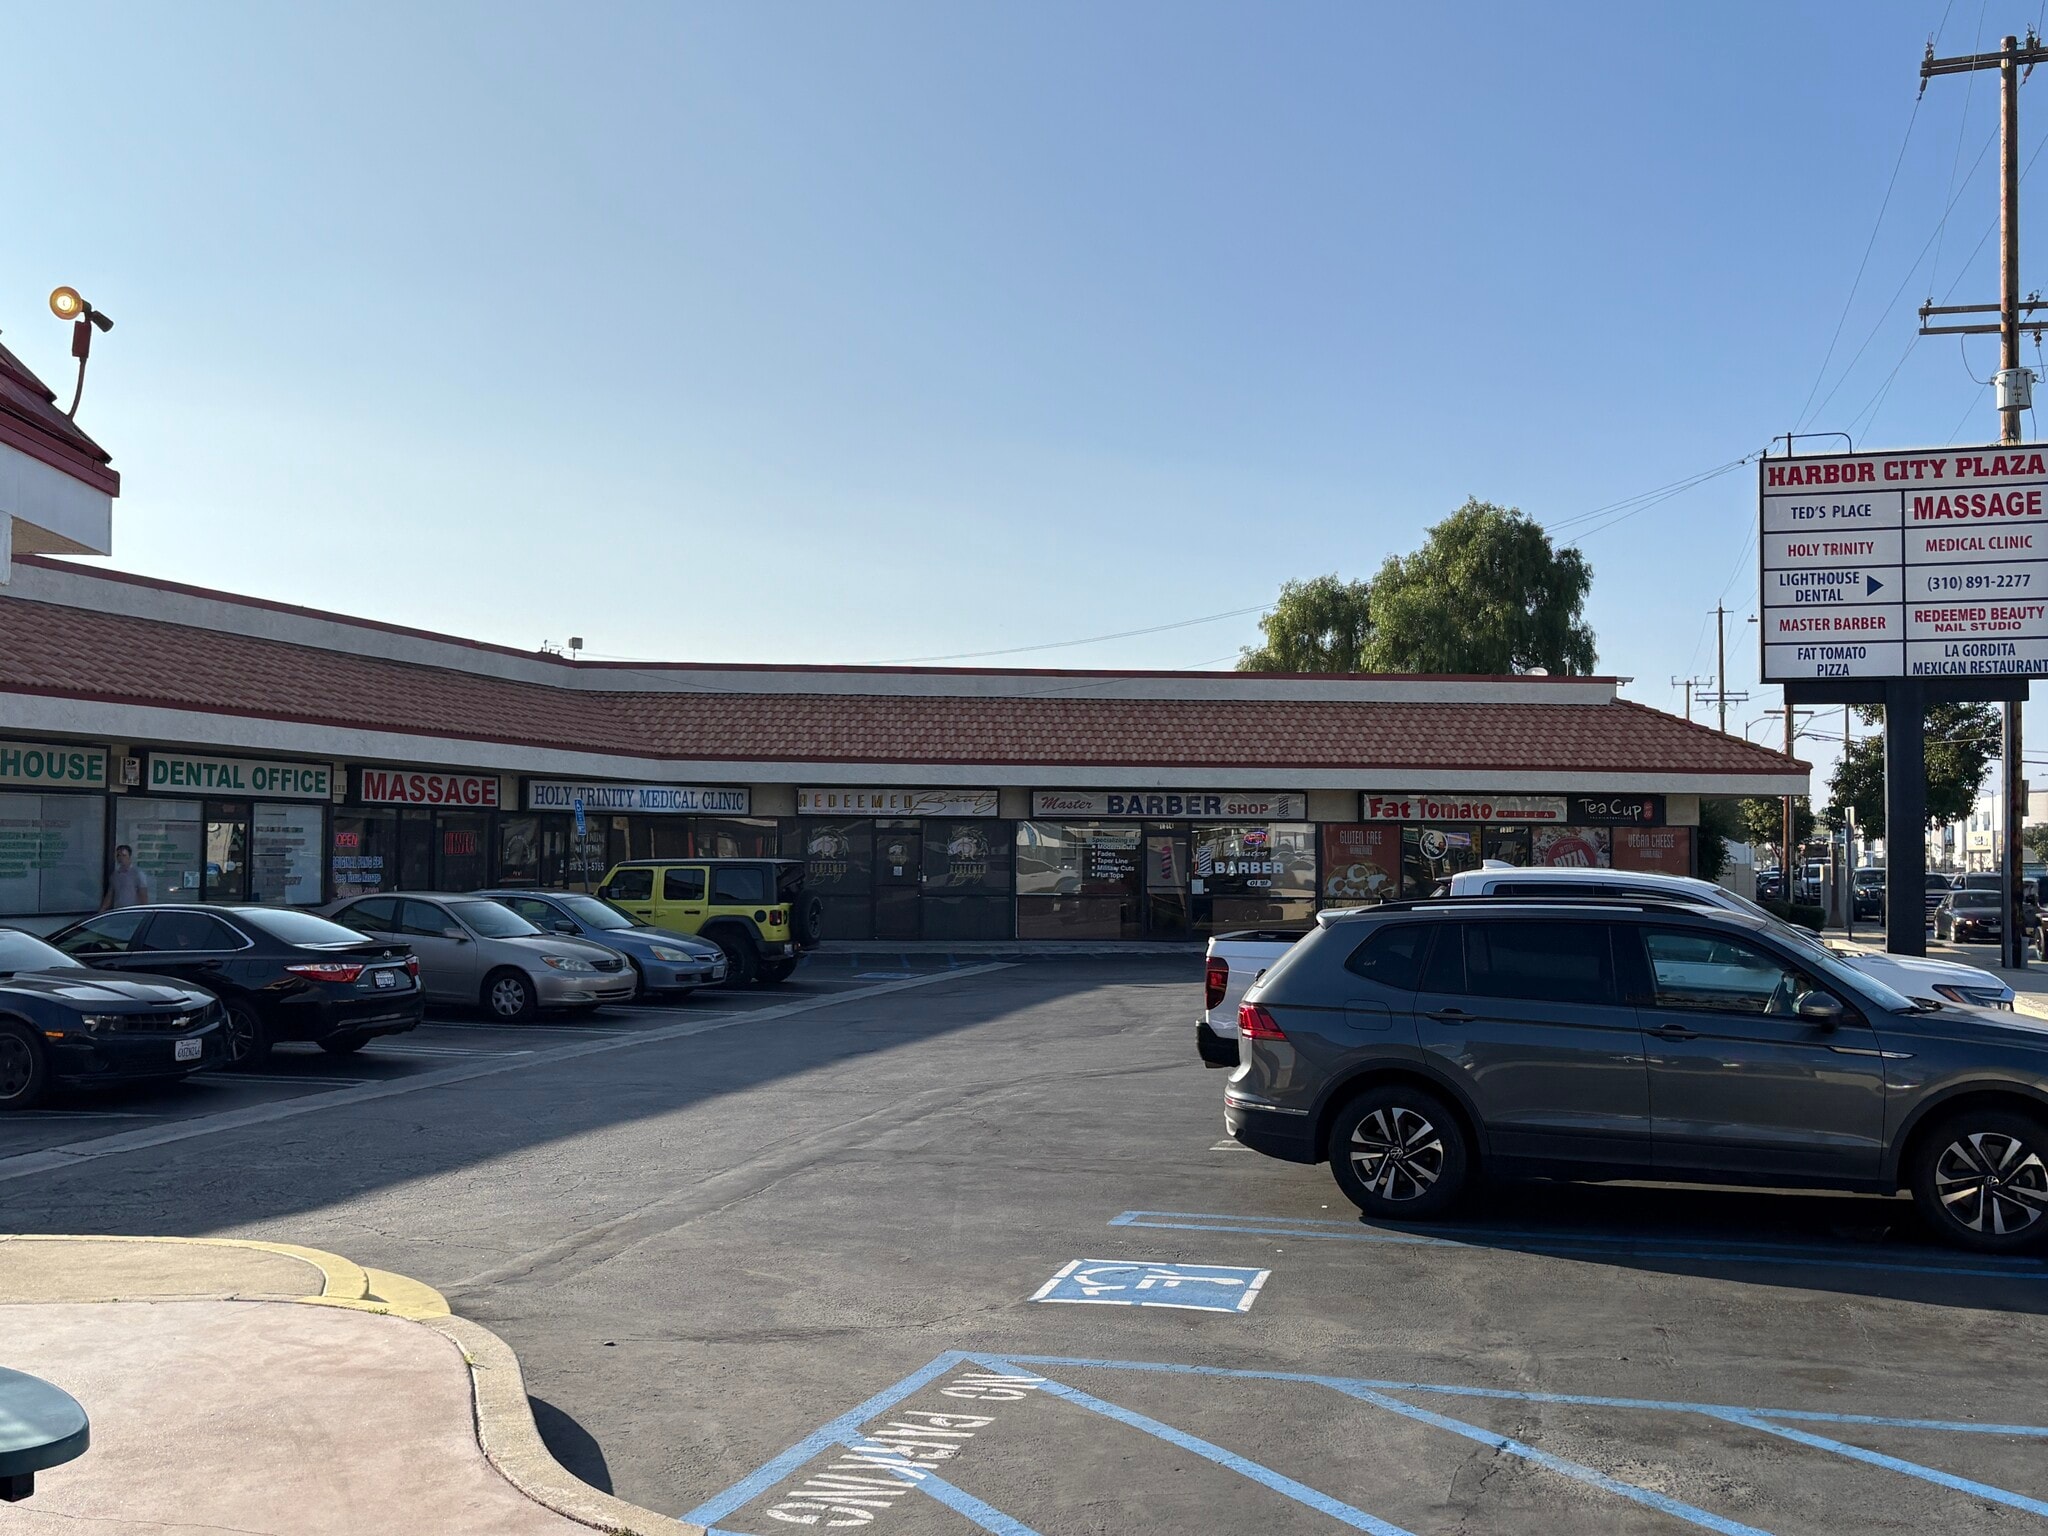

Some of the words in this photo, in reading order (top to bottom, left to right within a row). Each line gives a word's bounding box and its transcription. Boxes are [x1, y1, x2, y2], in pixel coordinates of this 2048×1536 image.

[1768, 462, 1875, 487] HARBOR
[1884, 458, 1947, 481] CITY
[1955, 454, 2046, 478] PLAZA
[1791, 505, 1826, 520] TED'S
[1833, 504, 1872, 518] PLACE
[1913, 491, 2042, 520] MASSAGE
[1788, 543, 1820, 557] HOLY
[1822, 541, 1874, 556] TRINITY
[1926, 537, 1985, 552] MEDICAL
[1988, 535, 2033, 550] CLINIC
[1779, 571, 1860, 587] LIGHTHOUSE
[1927, 575, 1962, 592] (310)
[1965, 574, 2031, 589] 891-2277
[1795, 588, 1844, 602] DENTAL
[1914, 607, 1986, 623] REDEEMED
[1990, 606, 2045, 621] BEAUTY
[1779, 618, 1830, 632] MASTER
[1834, 616, 1886, 631] BARBER
[1934, 623, 1967, 633] NAIL
[1970, 621, 2022, 632] STUDIO
[1797, 647, 1817, 661] FAT
[1819, 646, 1867, 660] TOMATO
[1944, 644, 1960, 658] LA
[1962, 643, 2016, 657] GORDITA
[1816, 663, 1850, 677] PIZZA
[1912, 661, 1968, 676] MEXICAN
[1970, 659, 2048, 674] RESTAURANT
[0, 749, 103, 781] HOUSE
[153, 759, 245, 789] DENTAL
[252, 767, 327, 793] OFFICE
[363, 771, 497, 805] MASSAGE
[534, 785, 572, 806] HOLY
[577, 787, 635, 808] TRINITY
[639, 789, 698, 810] MEDICAL
[702, 791, 744, 811] CLINIC
[1040, 796, 1093, 810] Master
[1107, 795, 1222, 815] BARBER
[1227, 803, 1269, 815] SHOP
[1368, 797, 1411, 819] Fat
[1417, 798, 1493, 819] Tomato
[1578, 798, 1607, 814] Tea
[1610, 799, 1642, 821] Cup
[1339, 830, 1364, 844] GLUTEN
[1366, 831, 1382, 845] FREE
[1628, 834, 1650, 848] VEGAN
[1651, 834, 1675, 848] CHEESE
[1214, 861, 1284, 874] BARBER
[939, 1372, 1048, 1401] NO
[766, 1410, 996, 1527] PARKING
